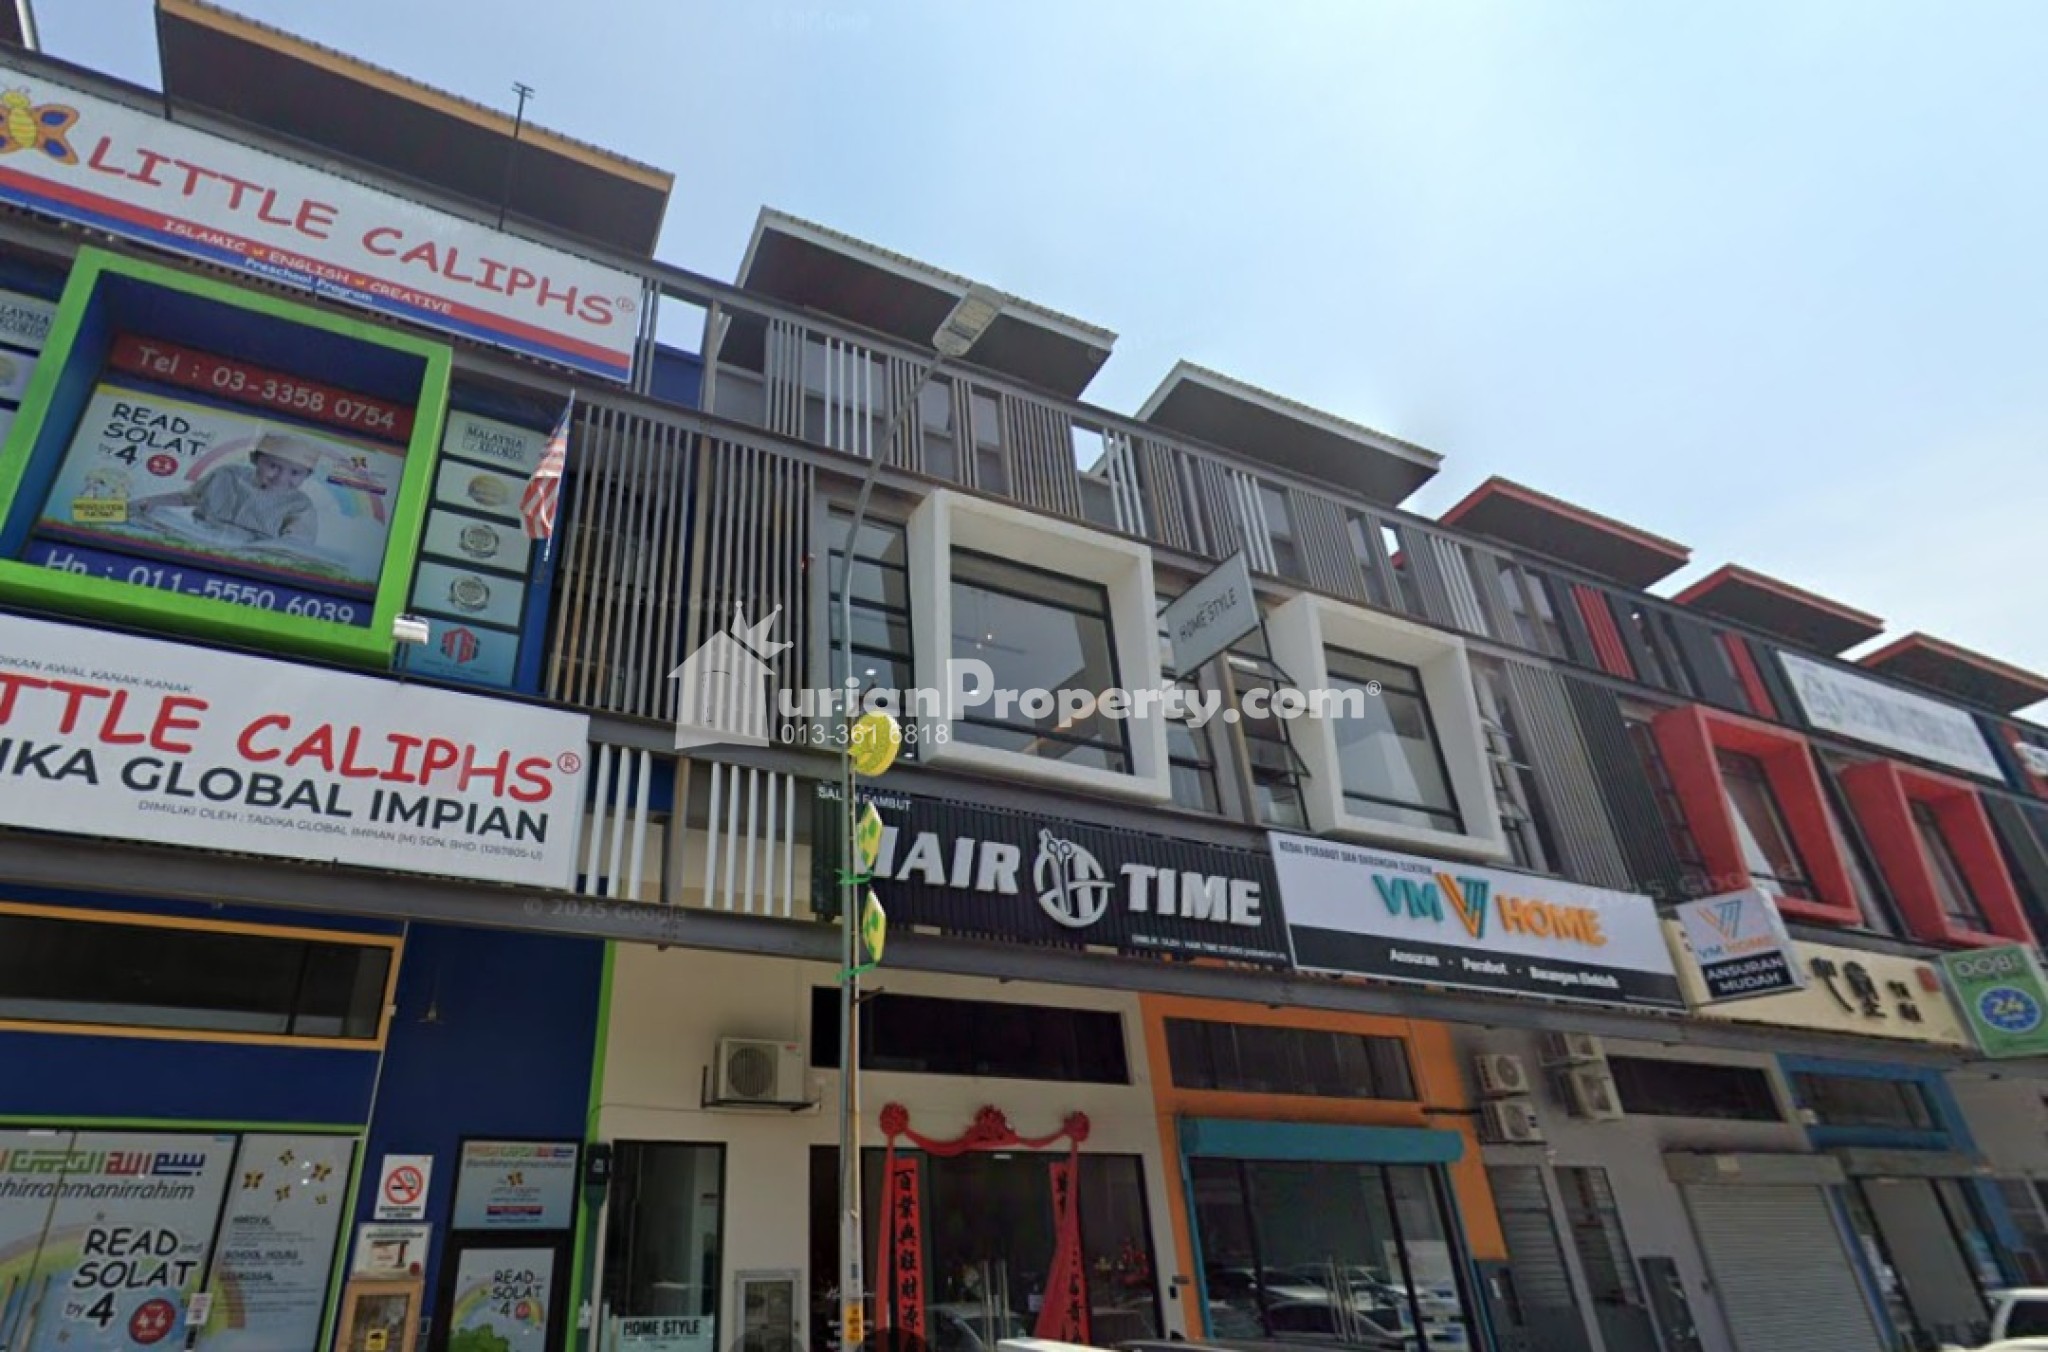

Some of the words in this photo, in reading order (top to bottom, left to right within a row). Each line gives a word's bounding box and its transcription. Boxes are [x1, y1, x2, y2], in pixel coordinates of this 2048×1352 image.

[88, 136, 339, 239] LITTLE
[164, 221, 246, 251] ISLAMIC
[268, 251, 351, 281] ENGLISH
[369, 281, 453, 314] CREATIVE
[245, 257, 313, 284] Preschool
[316, 278, 373, 303] Program
[138, 346, 177, 375] Tel
[211, 366, 324, 412] 03-3358
[334, 399, 395, 430] 0754
[112, 402, 190, 435] READ
[103, 422, 206, 456] SOLAT
[114, 445, 138, 466] 4
[44, 663, 86, 678] AWAL
[121, 756, 352, 818] GLOBAL
[369, 789, 549, 844] IMPIAN
[199, 807, 237, 821] OLEH
[247, 814, 295, 829] TADIKA
[297, 820, 348, 835] GLOBAL
[1120, 863, 1261, 927] TIME
[1372, 873, 1443, 922] VM
[1495, 894, 1608, 947] HOME
[1706, 956, 1783, 980] ANSURAN
[1955, 954, 2018, 977] DOBI
[1719, 972, 1780, 992] MUDAH
[84, 1228, 179, 1256] READ
[72, 1261, 197, 1288] SOLAT
[494, 1269, 535, 1284] READ
[491, 1284, 543, 1299] SOLAT
[65, 1302, 85, 1315] by
[86, 1292, 115, 1327] 4
[500, 1301, 511, 1316] 4
[623, 1320, 660, 1336] HOME
[662, 1319, 701, 1336] STYLE
